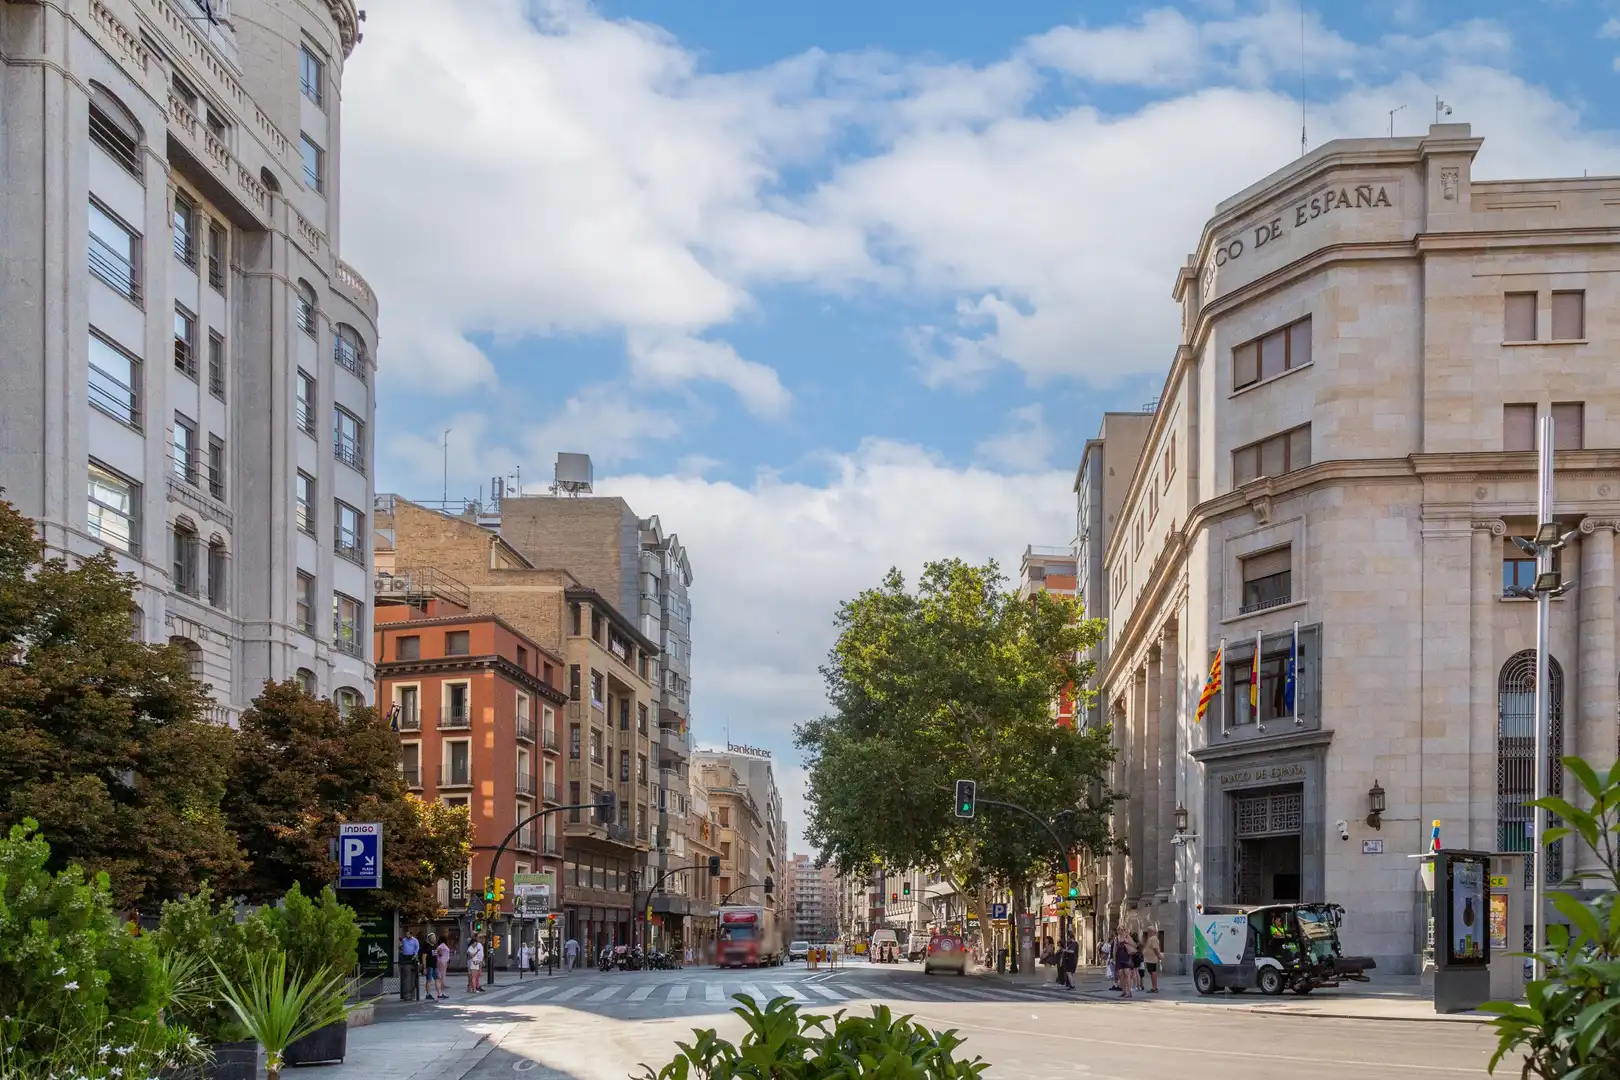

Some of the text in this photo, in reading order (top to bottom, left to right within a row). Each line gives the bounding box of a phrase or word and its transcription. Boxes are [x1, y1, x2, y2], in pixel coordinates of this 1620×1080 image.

[1254, 217, 1284, 249] DE
[1294, 184, 1393, 228] ESPAÑA
[1220, 764, 1307, 785] BANCO DE ESPAÑA
[344, 825, 374, 833] INDIGO
[344, 838, 365, 866] P
[995, 905, 1005, 917] P
